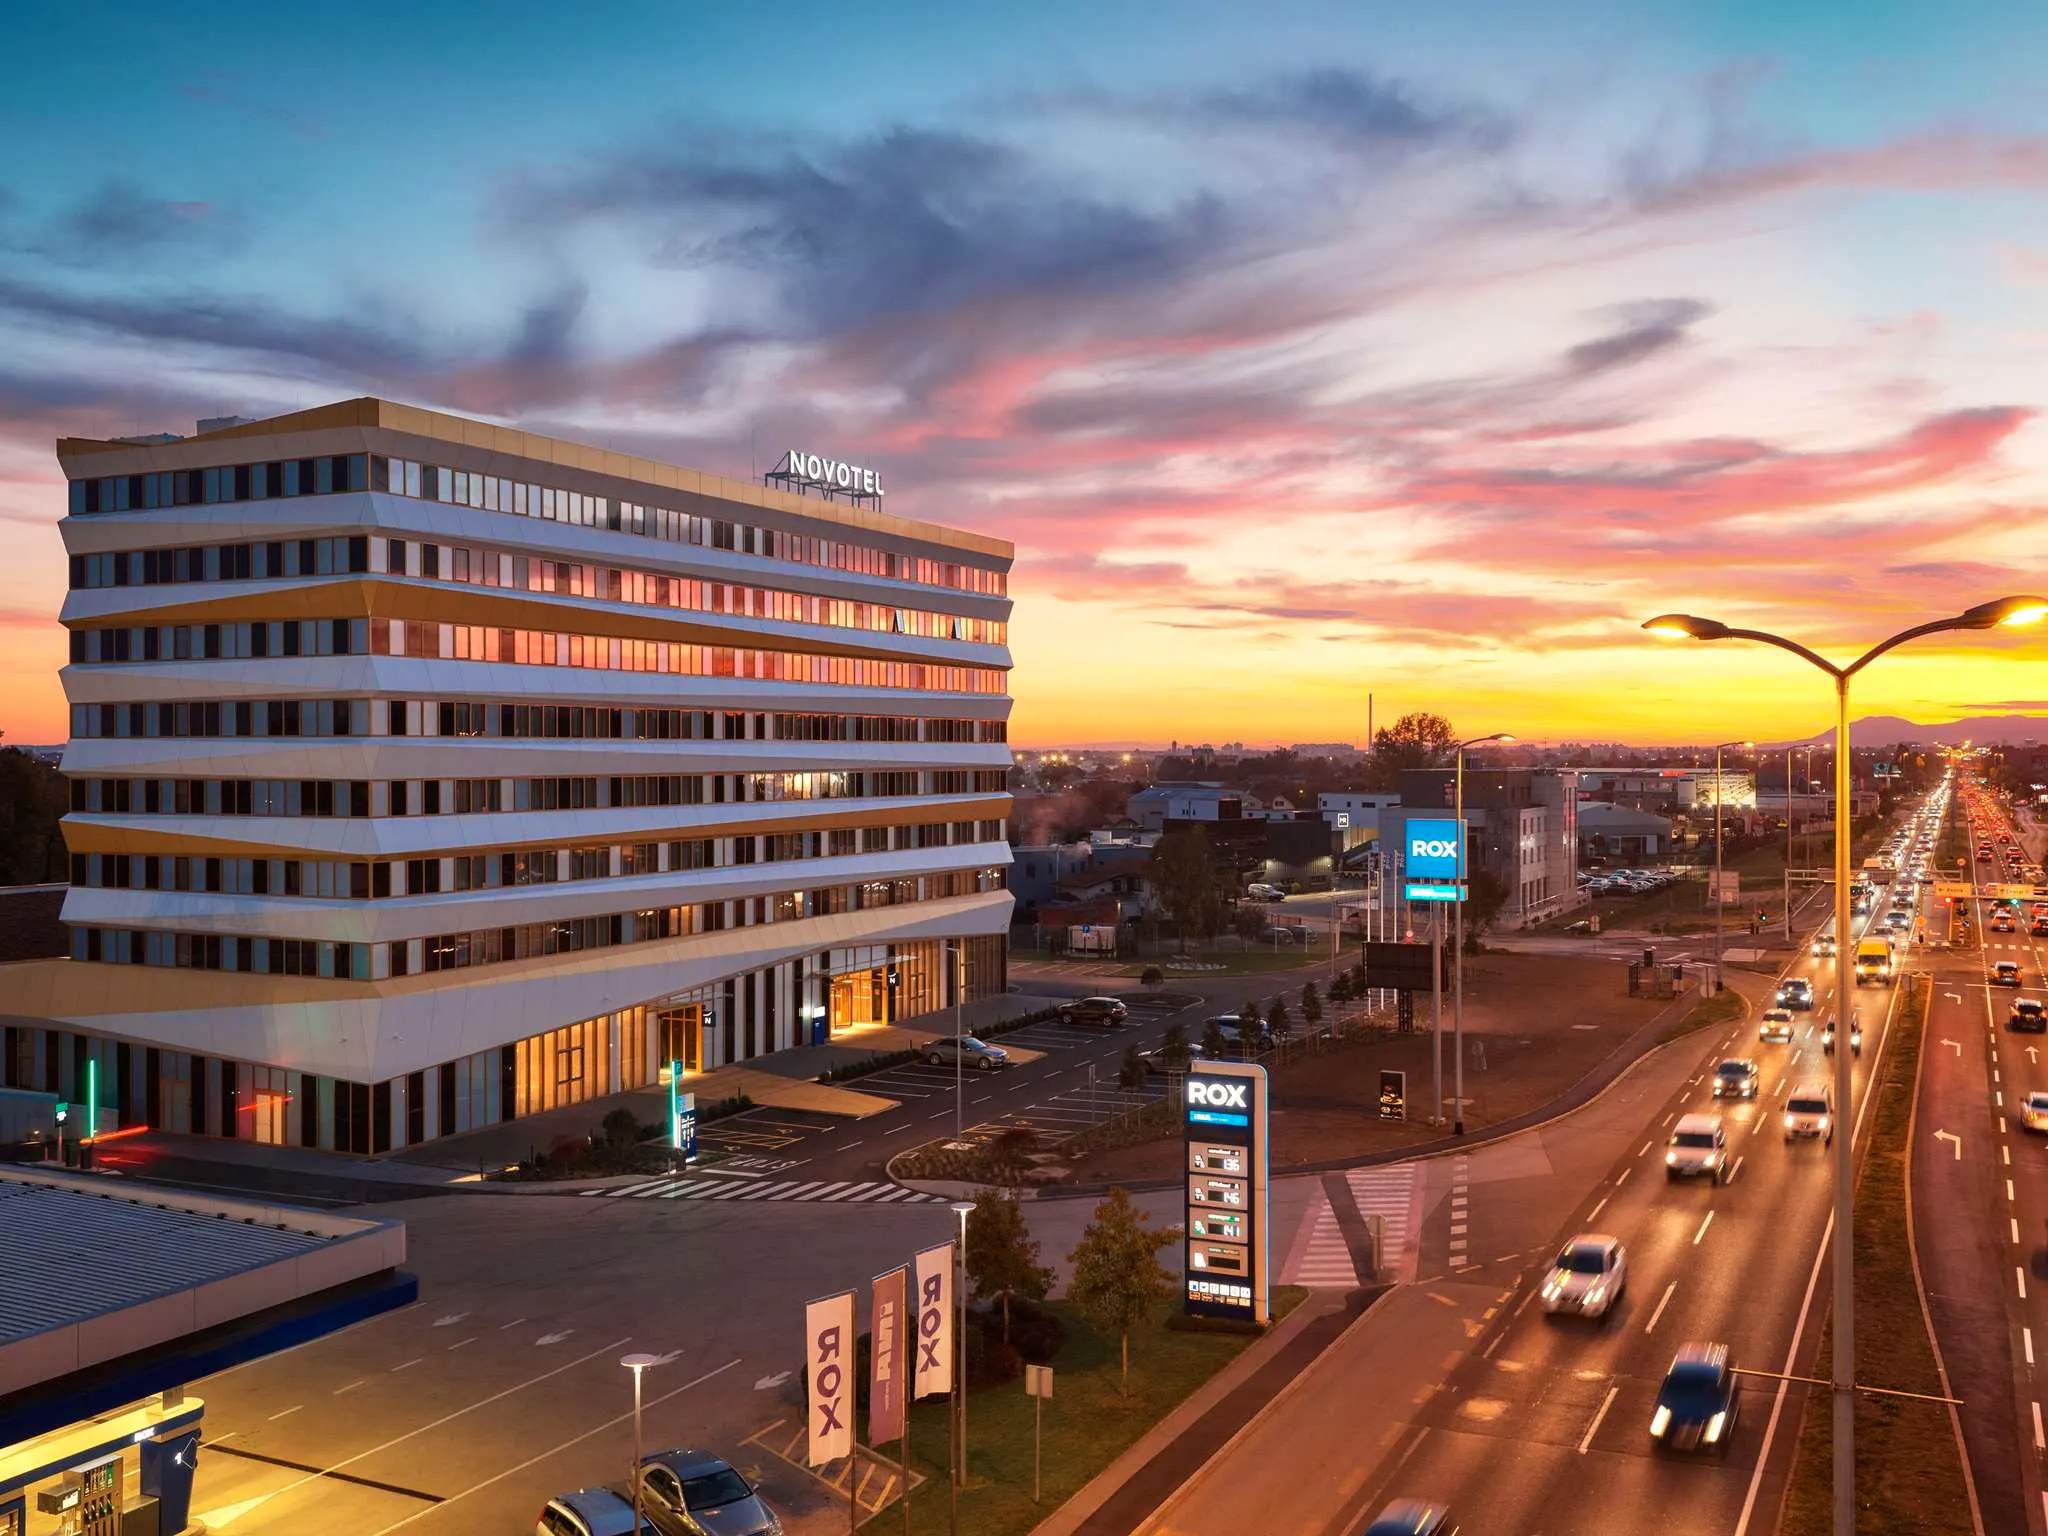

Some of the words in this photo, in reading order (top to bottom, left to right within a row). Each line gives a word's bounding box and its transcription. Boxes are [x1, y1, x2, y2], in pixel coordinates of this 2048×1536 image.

[790, 450, 885, 496] NOVOTEL
[1412, 839, 1457, 858] ROX
[1188, 1081, 1247, 1108] ROX
[174, 1452, 182, 1465] 1
